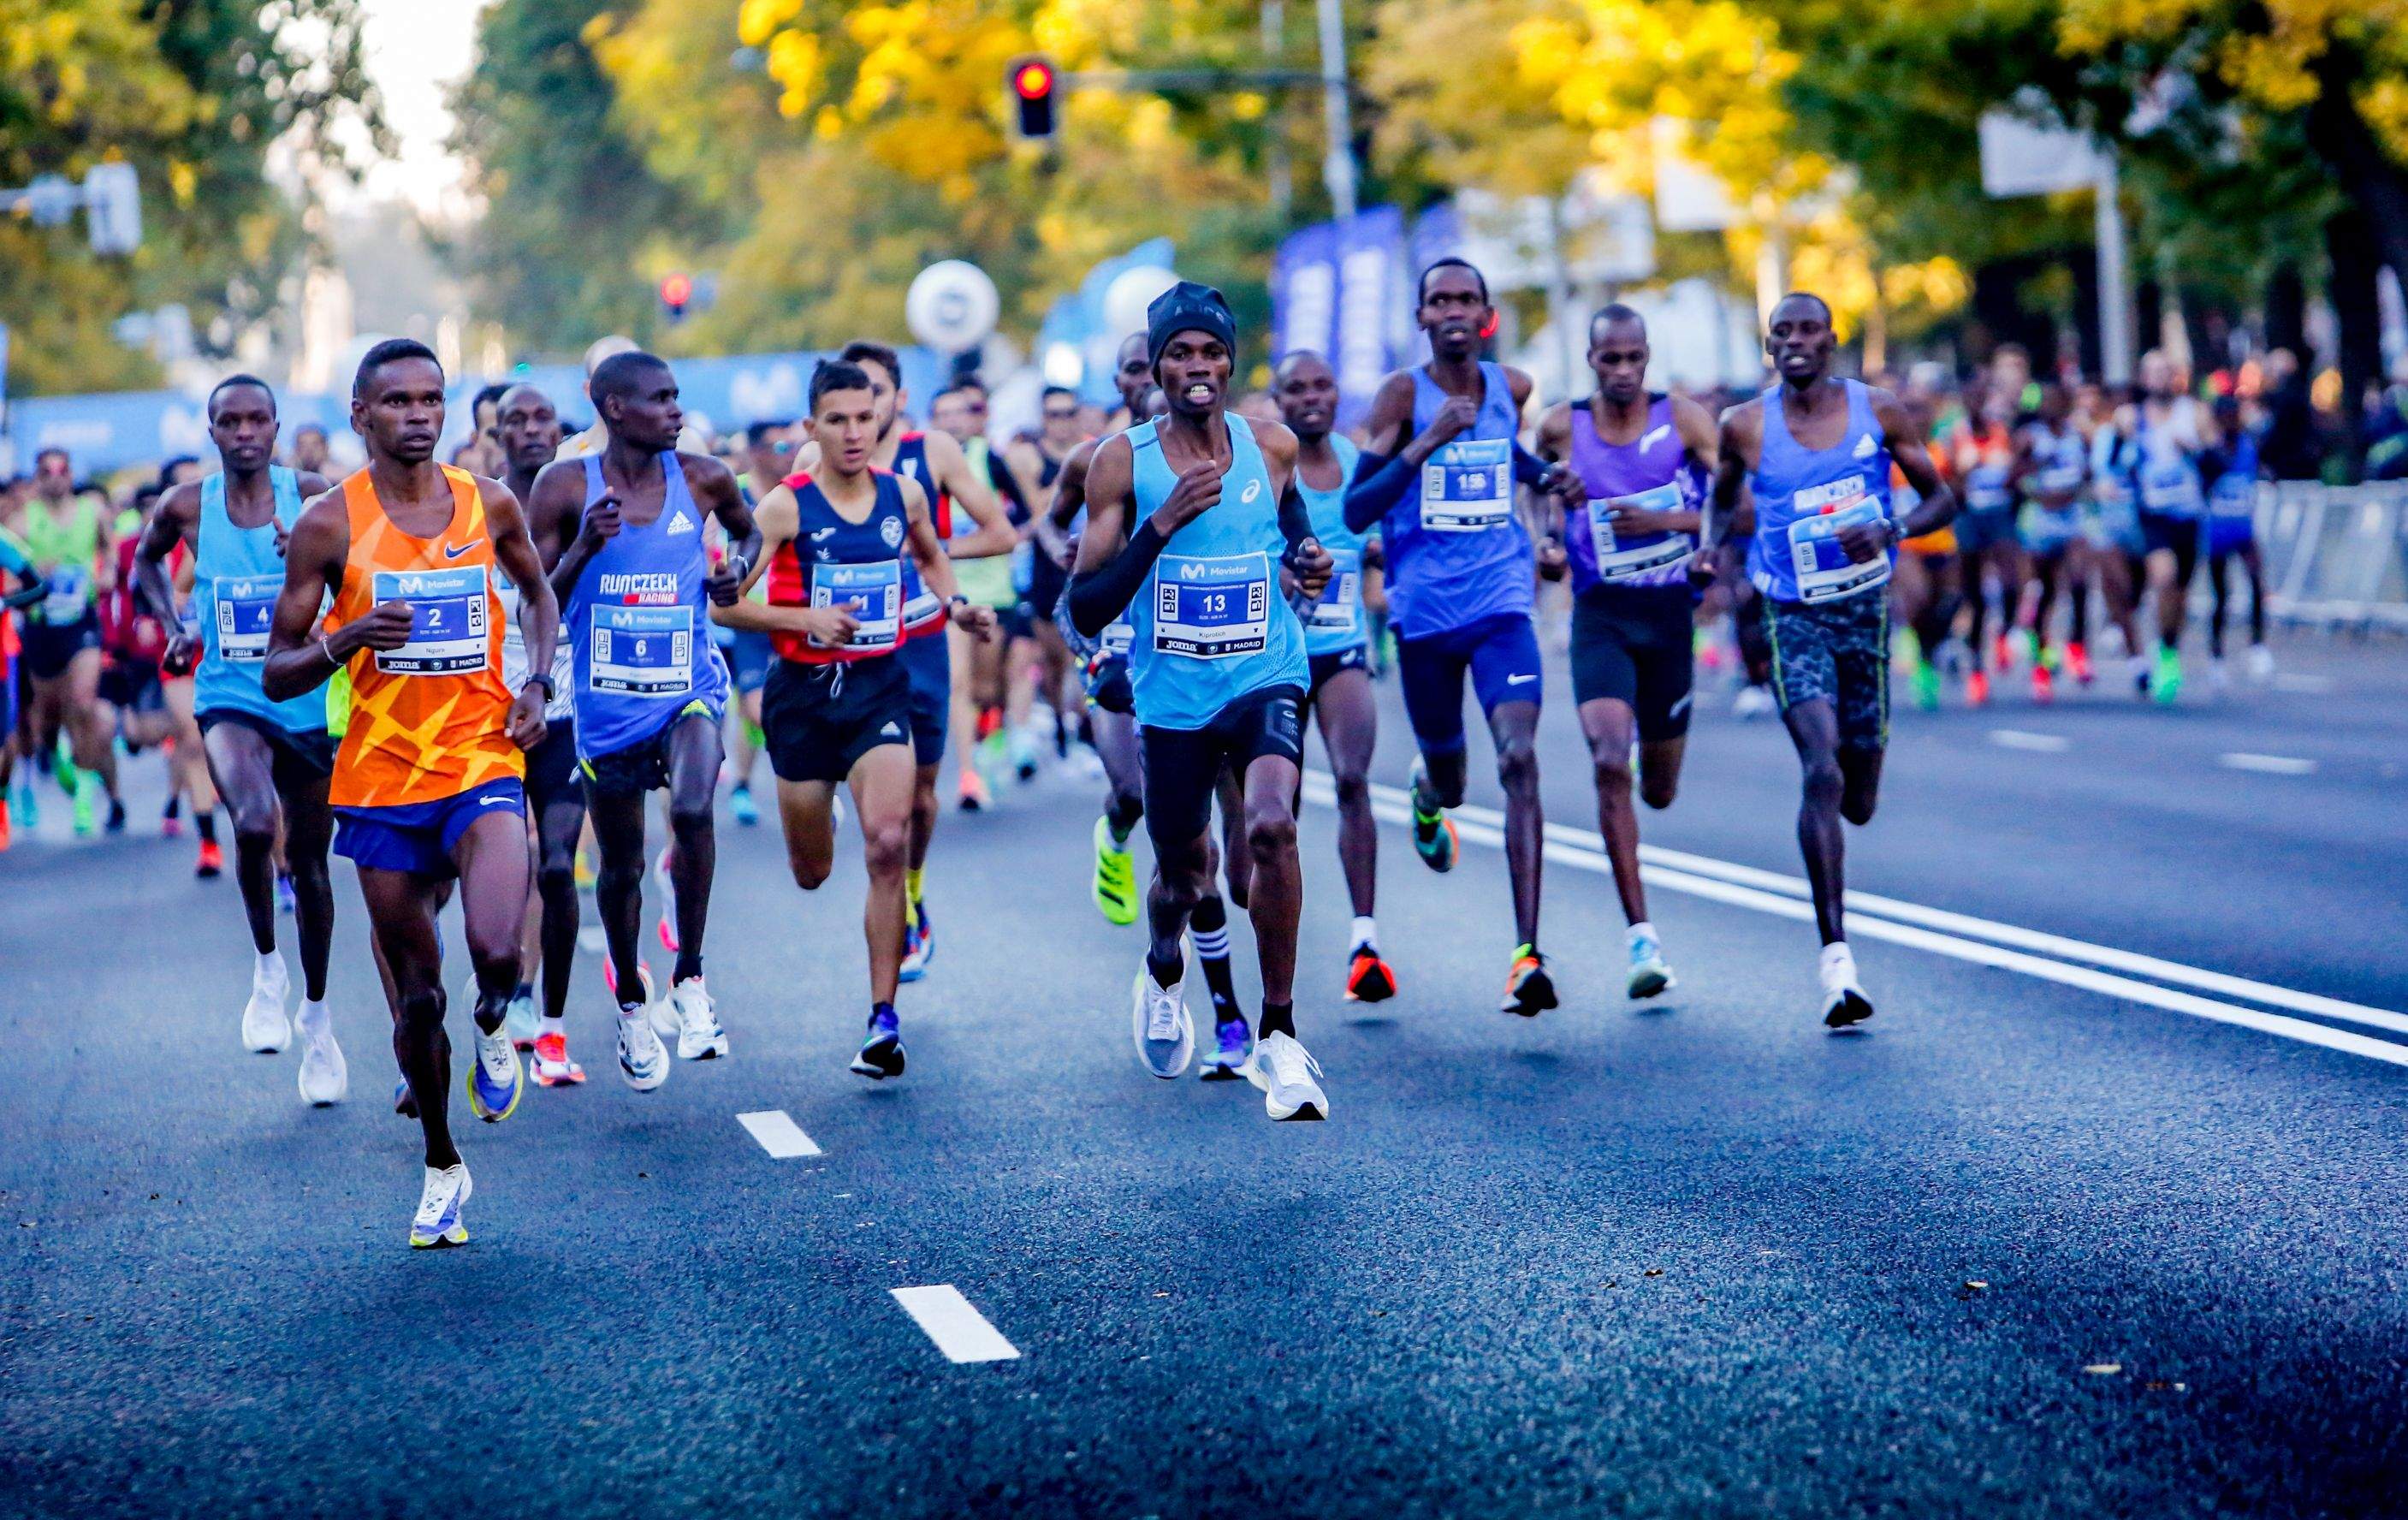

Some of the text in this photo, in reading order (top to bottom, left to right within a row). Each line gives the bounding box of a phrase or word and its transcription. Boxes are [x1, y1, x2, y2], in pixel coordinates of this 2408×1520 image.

[1210, 567, 1248, 576] Movistar
[427, 579, 466, 589] Movistar
[599, 573, 678, 595] RUNCZECH
[638, 592, 676, 603] RACING
[1203, 595, 1226, 613] 13
[428, 608, 442, 626] 2
[636, 615, 672, 624] Movistar
[635, 639, 647, 657] 6
[1233, 640, 1261, 650] MADRID
[459, 657, 483, 667] MADRID
